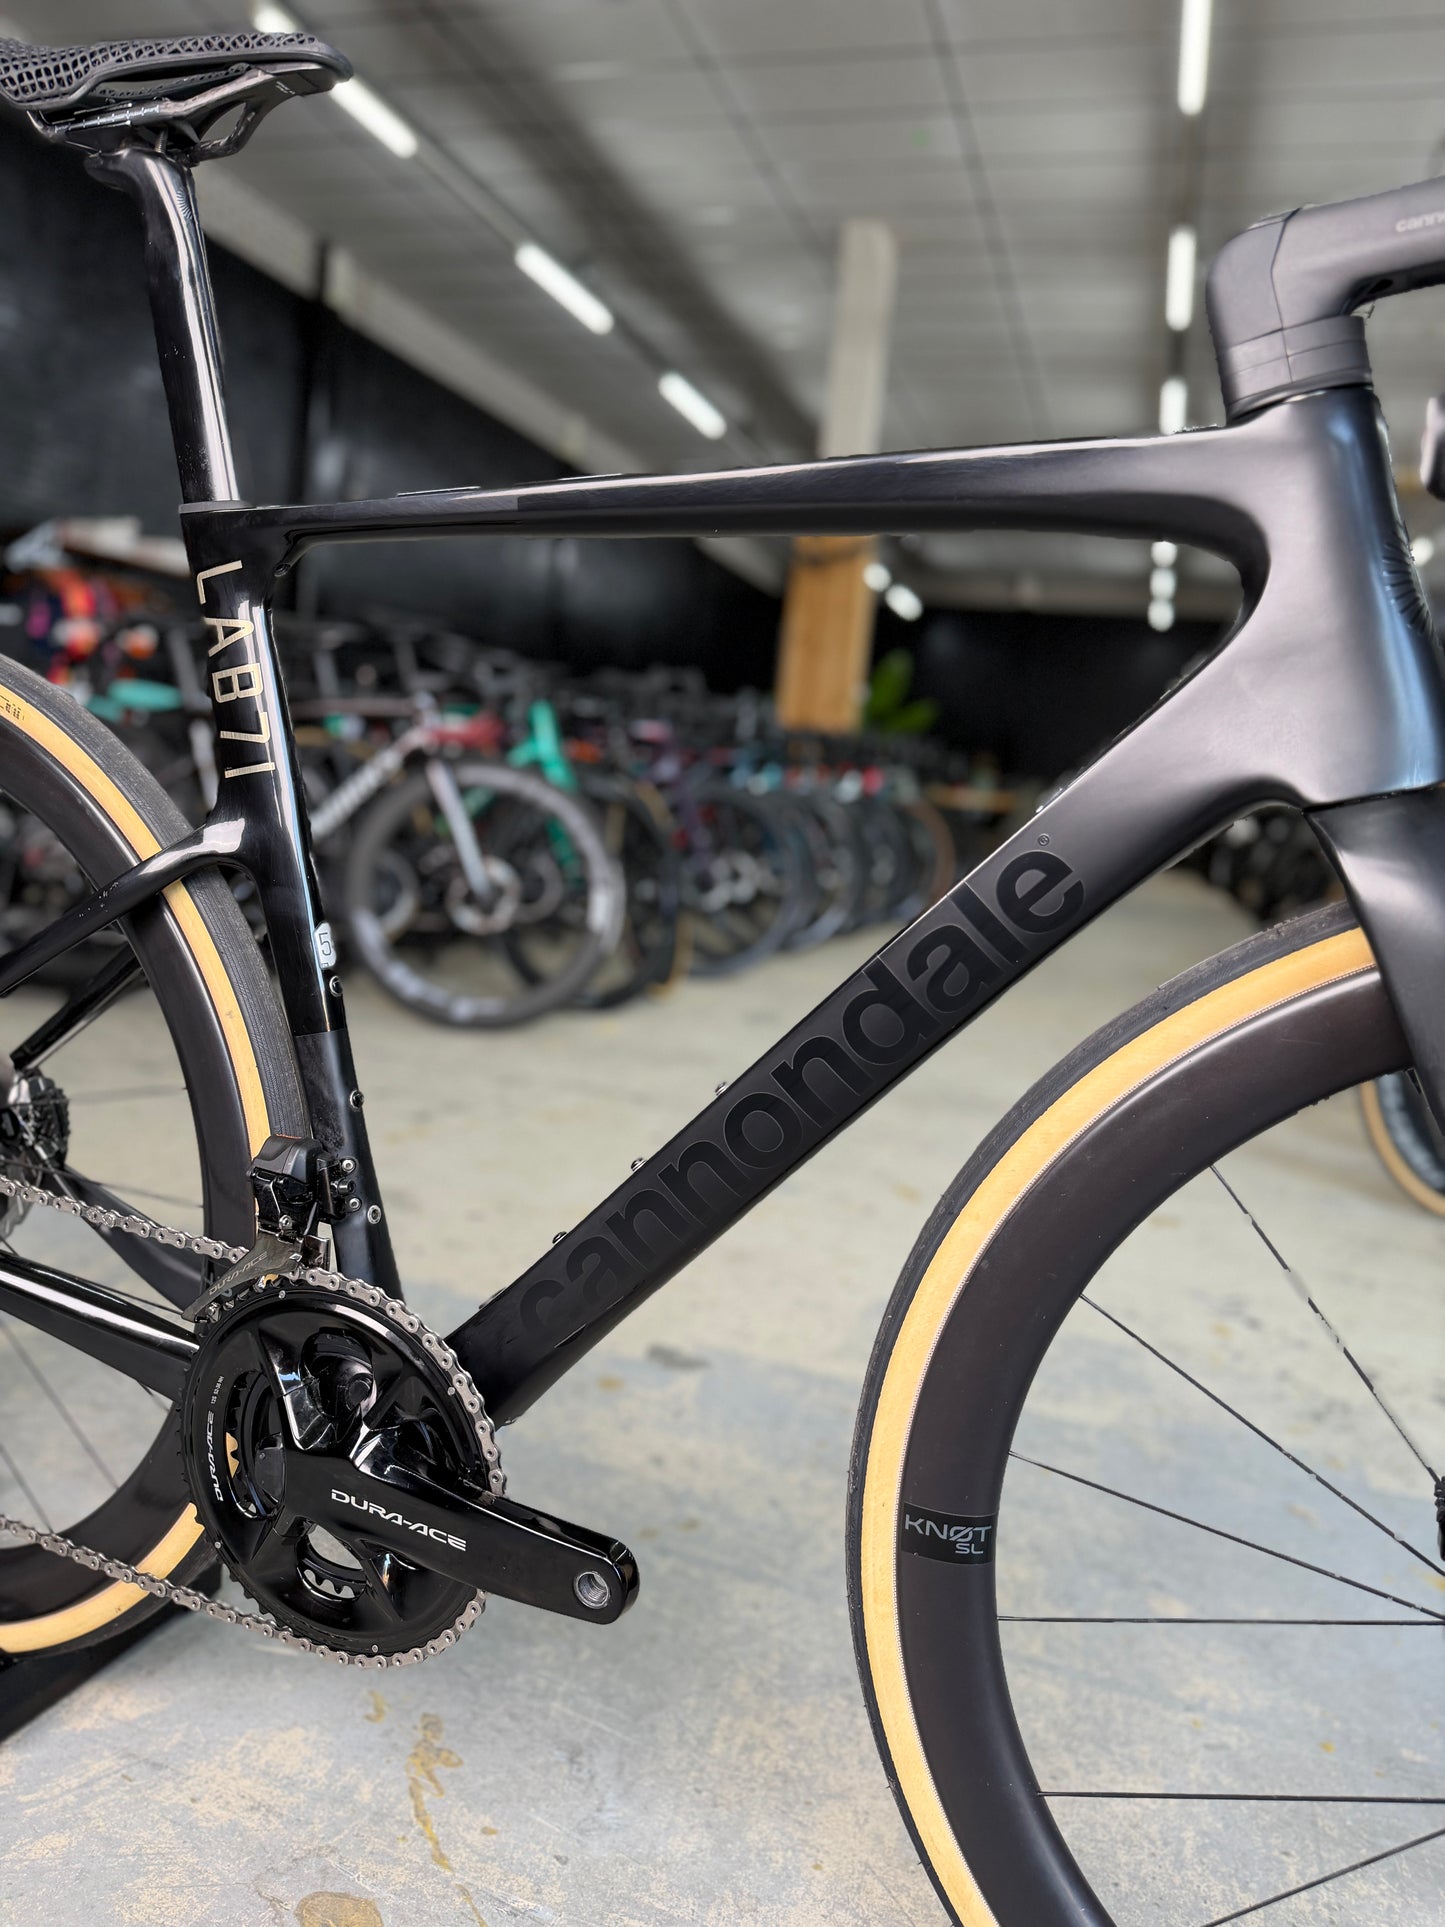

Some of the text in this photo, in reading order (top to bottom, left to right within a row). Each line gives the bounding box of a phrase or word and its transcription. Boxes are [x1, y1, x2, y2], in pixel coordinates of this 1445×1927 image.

[197, 560, 276, 778] LAB71
[318, 932, 332, 956] 5
[520, 850, 1085, 1338] cannondale
[209, 1251, 268, 1295] DURA-ACE
[206, 1410, 224, 1501] DURA-ACE
[331, 1489, 467, 1551] DURA-ACE
[955, 1543, 984, 1554] SL
